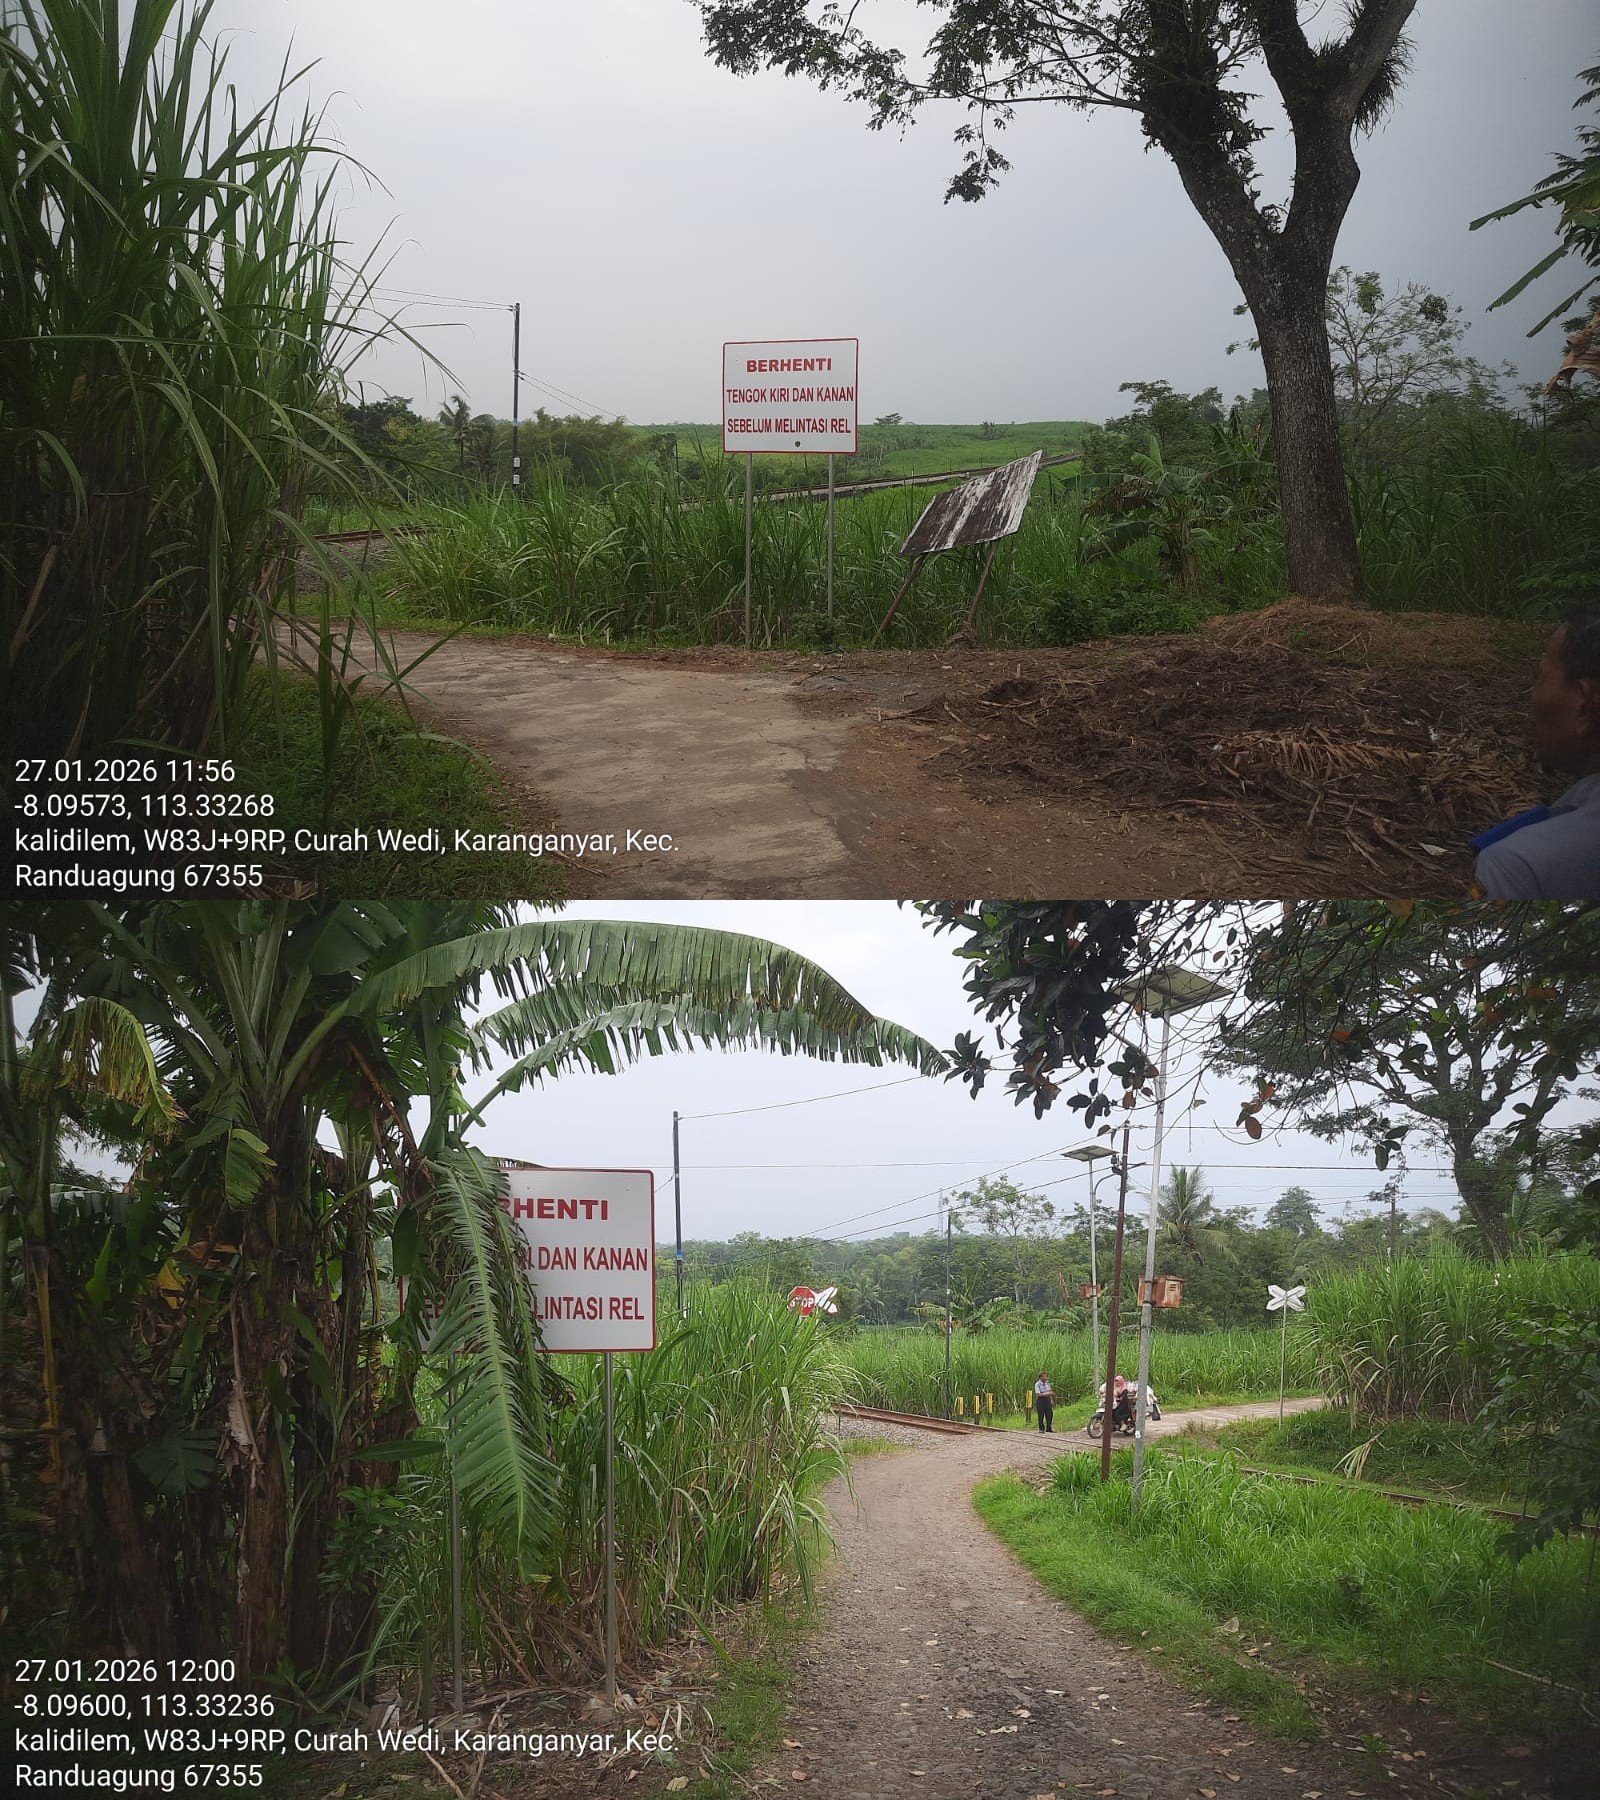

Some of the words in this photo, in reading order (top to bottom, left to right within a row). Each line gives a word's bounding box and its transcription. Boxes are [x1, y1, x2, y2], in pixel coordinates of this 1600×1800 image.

[746, 357, 832, 373] BERHENTI
[726, 388, 767, 403] TENGOK
[769, 387, 790, 403] KIRI
[792, 387, 814, 402] DAN
[816, 386, 854, 402] KANAN
[727, 418, 772, 433] SEBELUM
[775, 418, 828, 433] MELINTASI
[830, 418, 851, 433] REL
[497, 1197, 608, 1220] RHENTI
[538, 1246, 577, 1270] DAN
[583, 1247, 648, 1271] KANAN
[533, 1296, 603, 1321] LINTASI
[608, 1297, 645, 1321] REL
